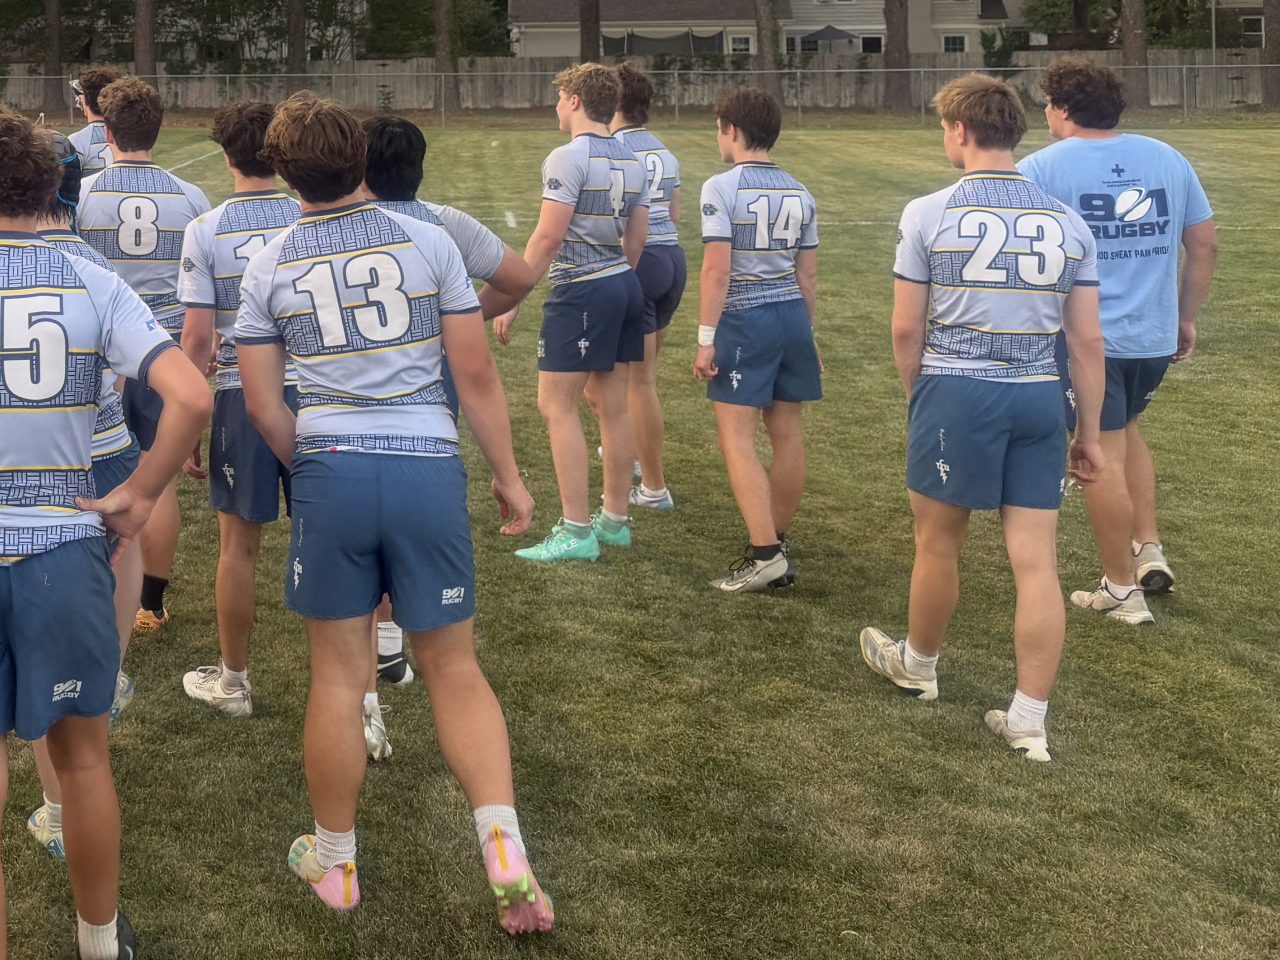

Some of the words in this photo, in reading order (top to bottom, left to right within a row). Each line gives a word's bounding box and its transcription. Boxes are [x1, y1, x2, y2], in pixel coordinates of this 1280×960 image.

[118, 196, 159, 256] 8
[747, 195, 804, 250] 14
[958, 210, 1067, 288] 23
[1088, 220, 1170, 240] RUGBY
[294, 252, 412, 353] 13
